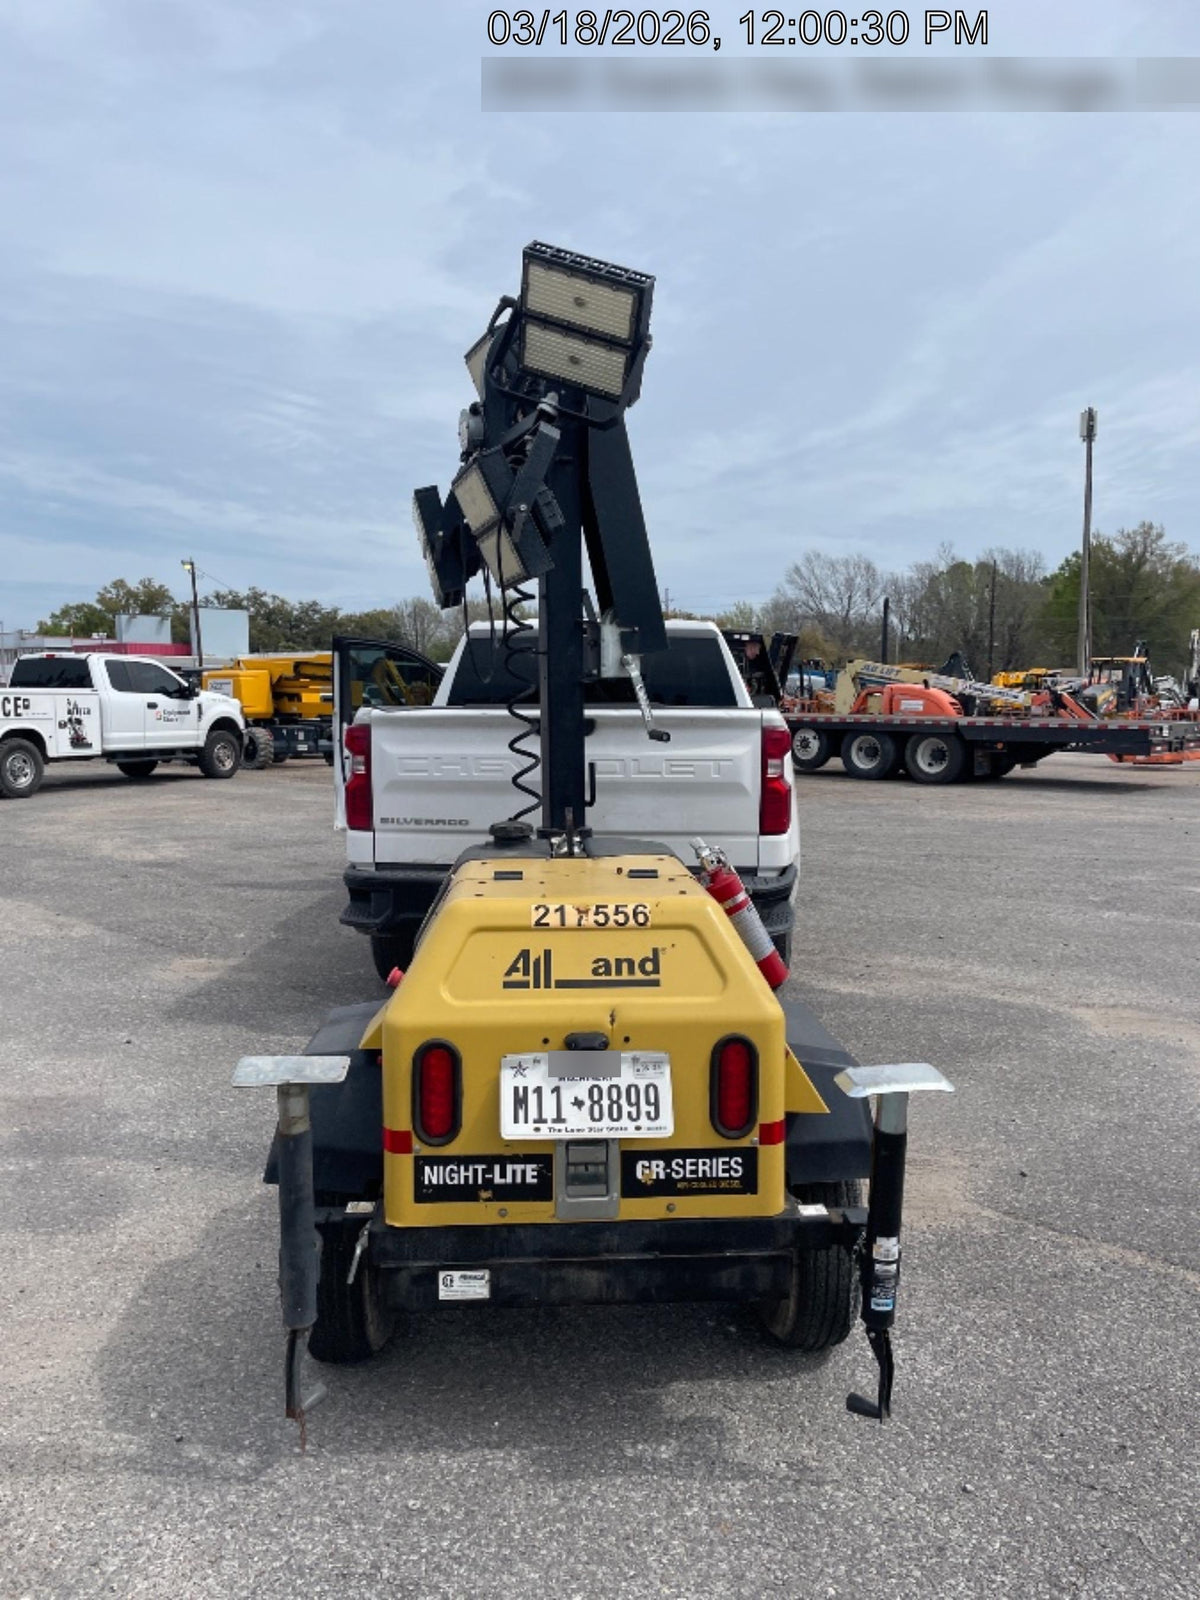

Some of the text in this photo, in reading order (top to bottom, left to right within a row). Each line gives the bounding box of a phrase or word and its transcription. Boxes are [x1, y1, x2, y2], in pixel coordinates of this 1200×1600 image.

[380, 817, 470, 826] SILVERADO
[513, 1083, 660, 1124] M11 8899
[424, 1164, 538, 1185] NIGHT-LITE
